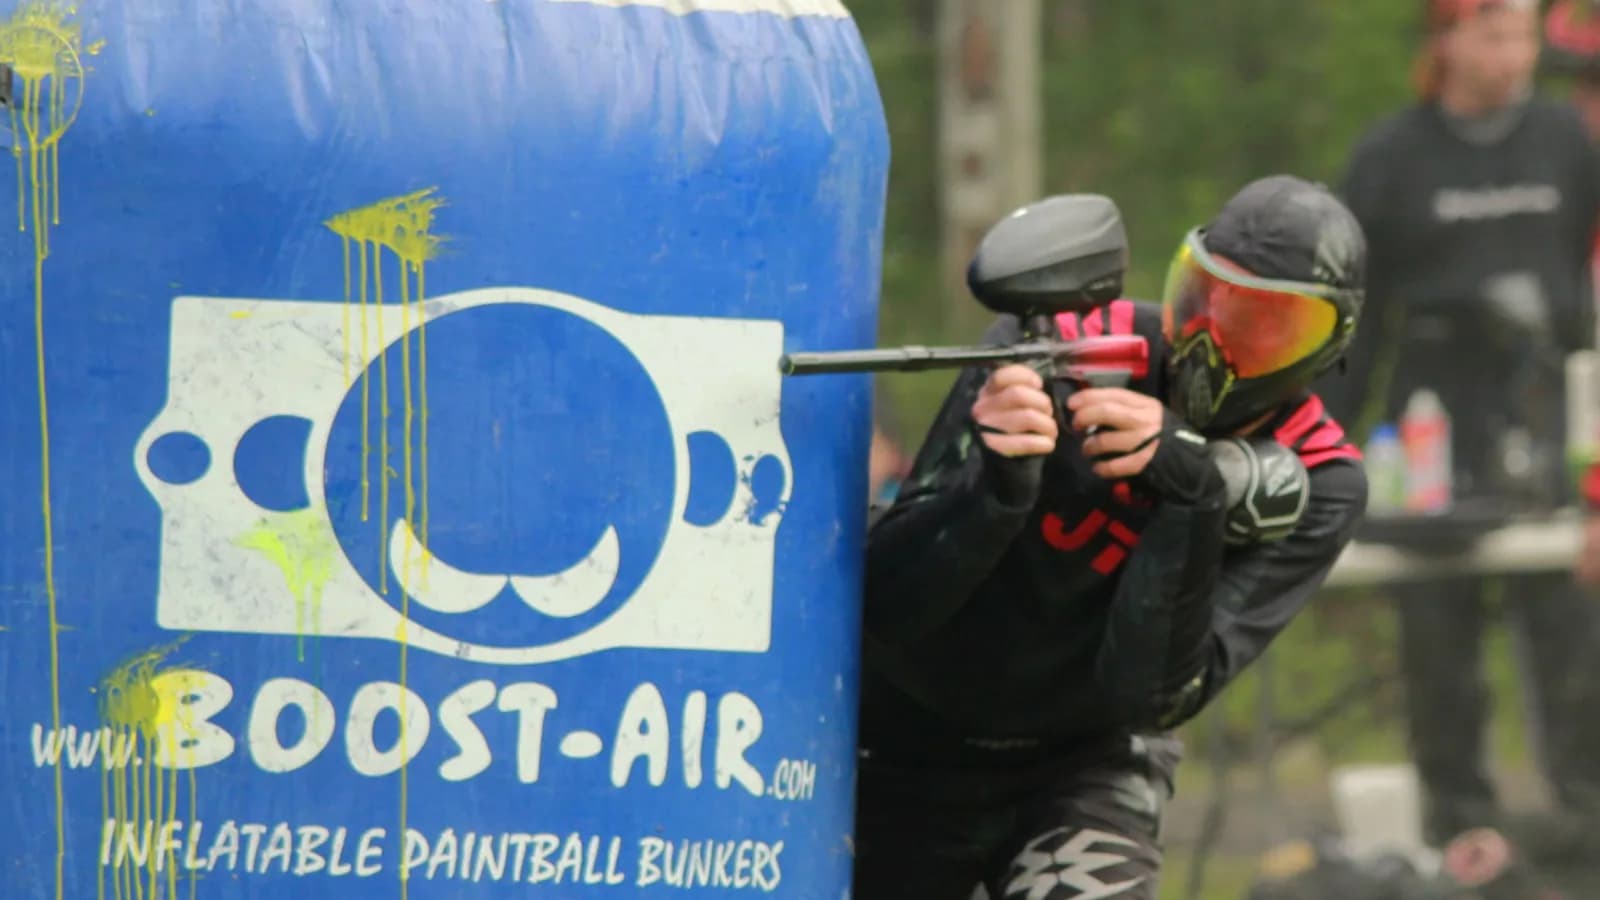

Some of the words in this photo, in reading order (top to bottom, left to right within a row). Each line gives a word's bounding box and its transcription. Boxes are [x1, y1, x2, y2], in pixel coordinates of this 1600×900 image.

[102, 818, 386, 880] INFLATABLE
[402, 828, 624, 885] PAINTBALL
[636, 836, 784, 892] BUNKERS
